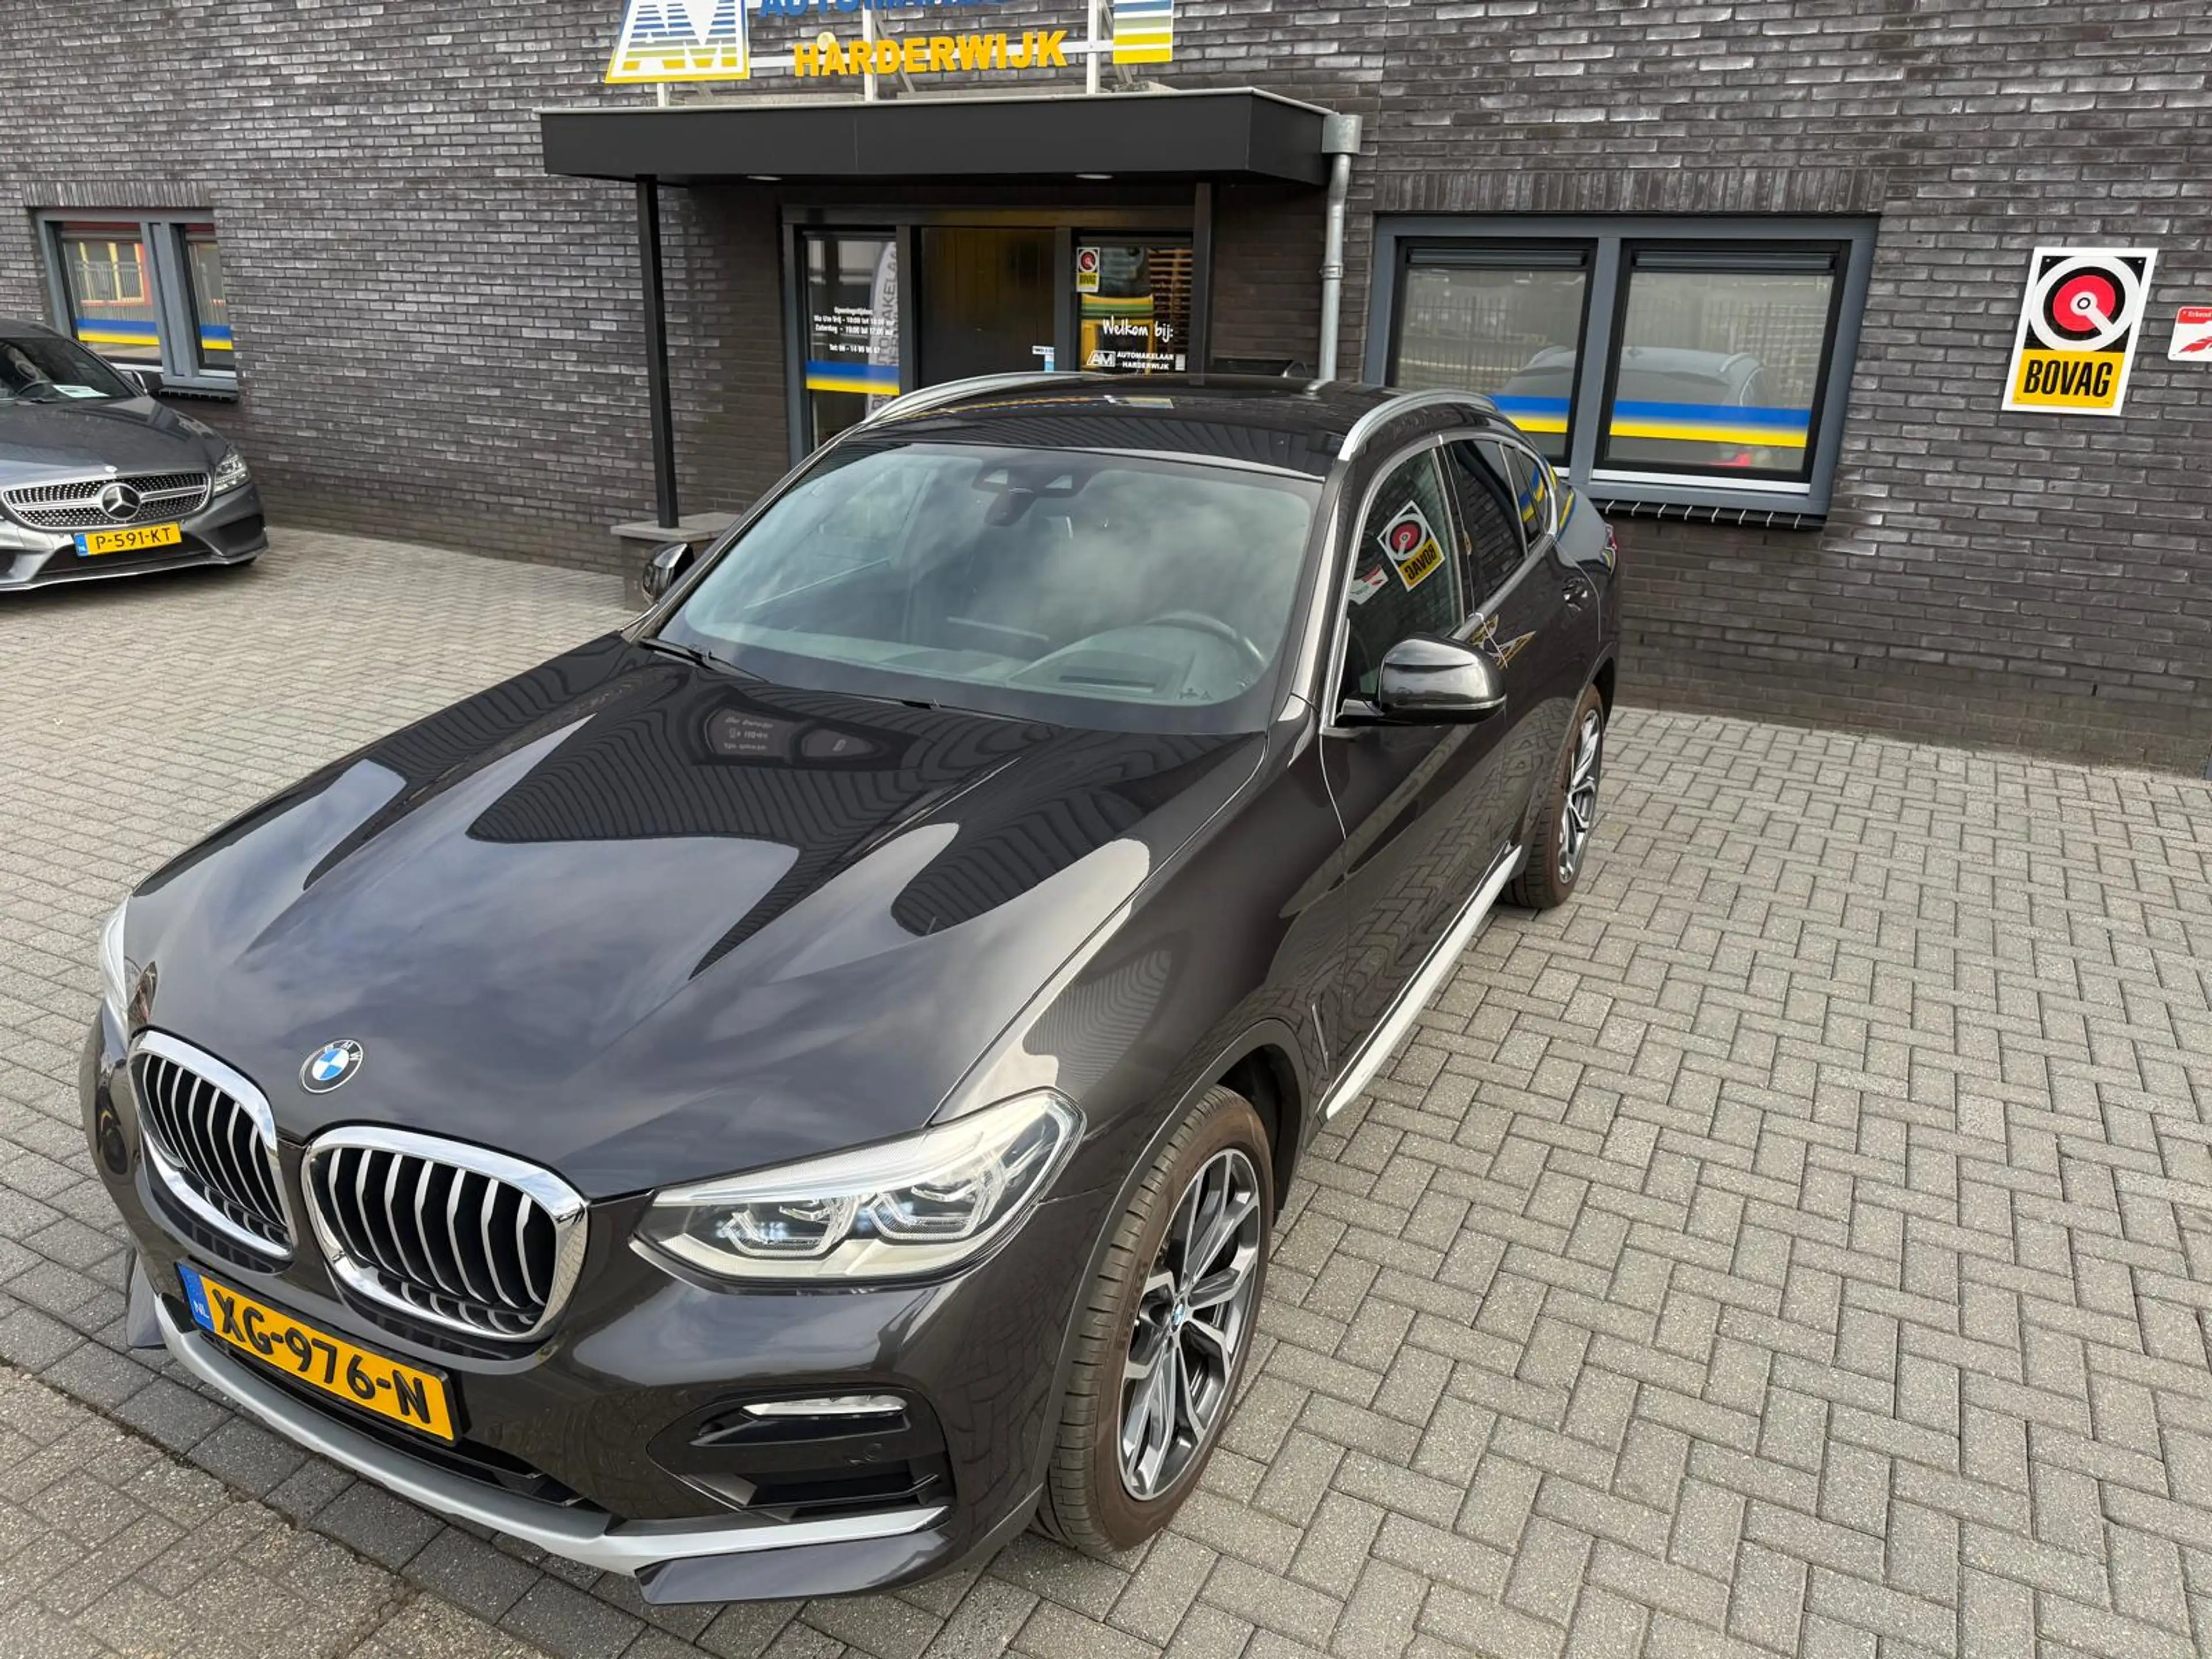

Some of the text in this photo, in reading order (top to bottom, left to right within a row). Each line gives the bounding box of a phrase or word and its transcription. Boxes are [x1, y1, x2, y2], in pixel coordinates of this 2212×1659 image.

[793, 30, 1069, 77] HARDERWIJK
[1103, 315, 1173, 343] Welkom bij:
[1117, 351, 1174, 361] AUTOMAKELAAR
[1122, 361, 1169, 370] HARDERWIJK
[2023, 359, 2113, 397] BOVAG
[95, 527, 171, 550] P-591-KT
[193, 1287, 431, 1425] NL XG-976-N
